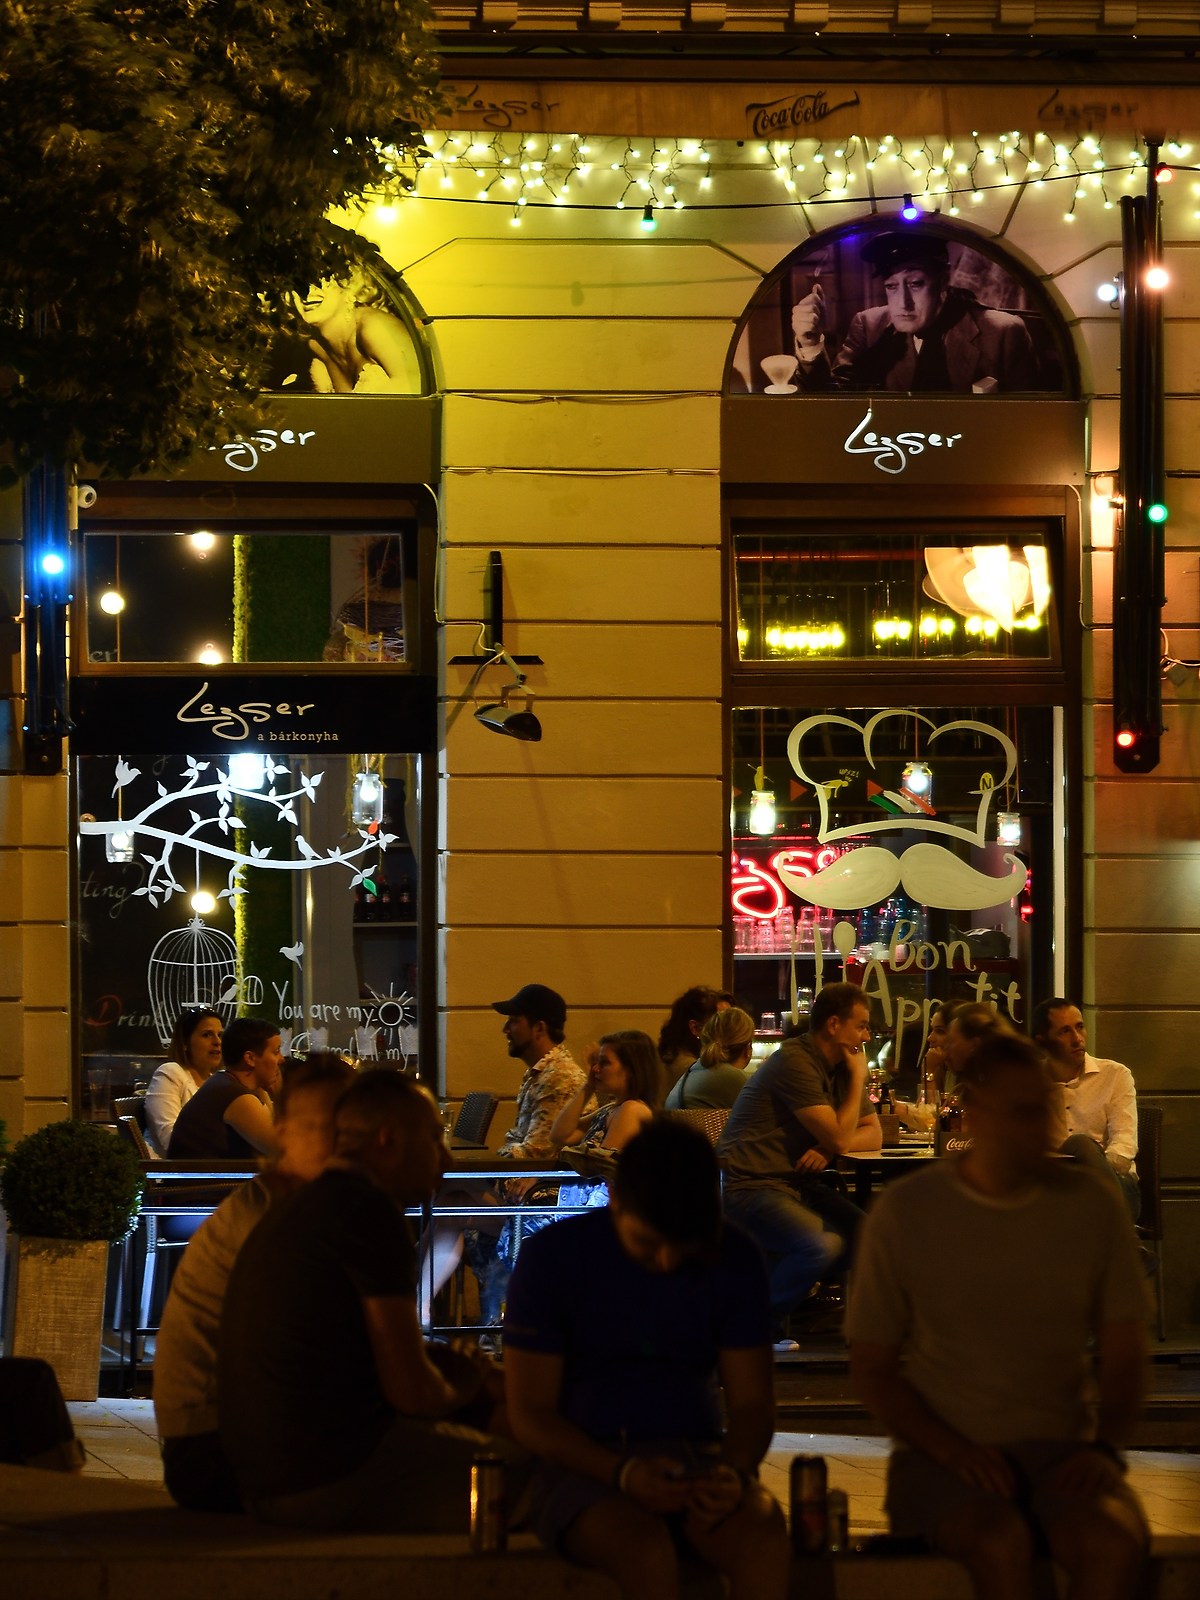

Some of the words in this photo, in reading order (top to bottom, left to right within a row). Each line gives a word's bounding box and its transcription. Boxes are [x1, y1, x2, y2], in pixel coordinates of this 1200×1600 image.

[257, 732, 265, 742] a
[270, 730, 339, 744] bárkonyha
[272, 980, 303, 1021] You
[309, 1004, 340, 1022] are
[346, 1005, 376, 1034] my
[861, 960, 1023, 1068] Apptit
